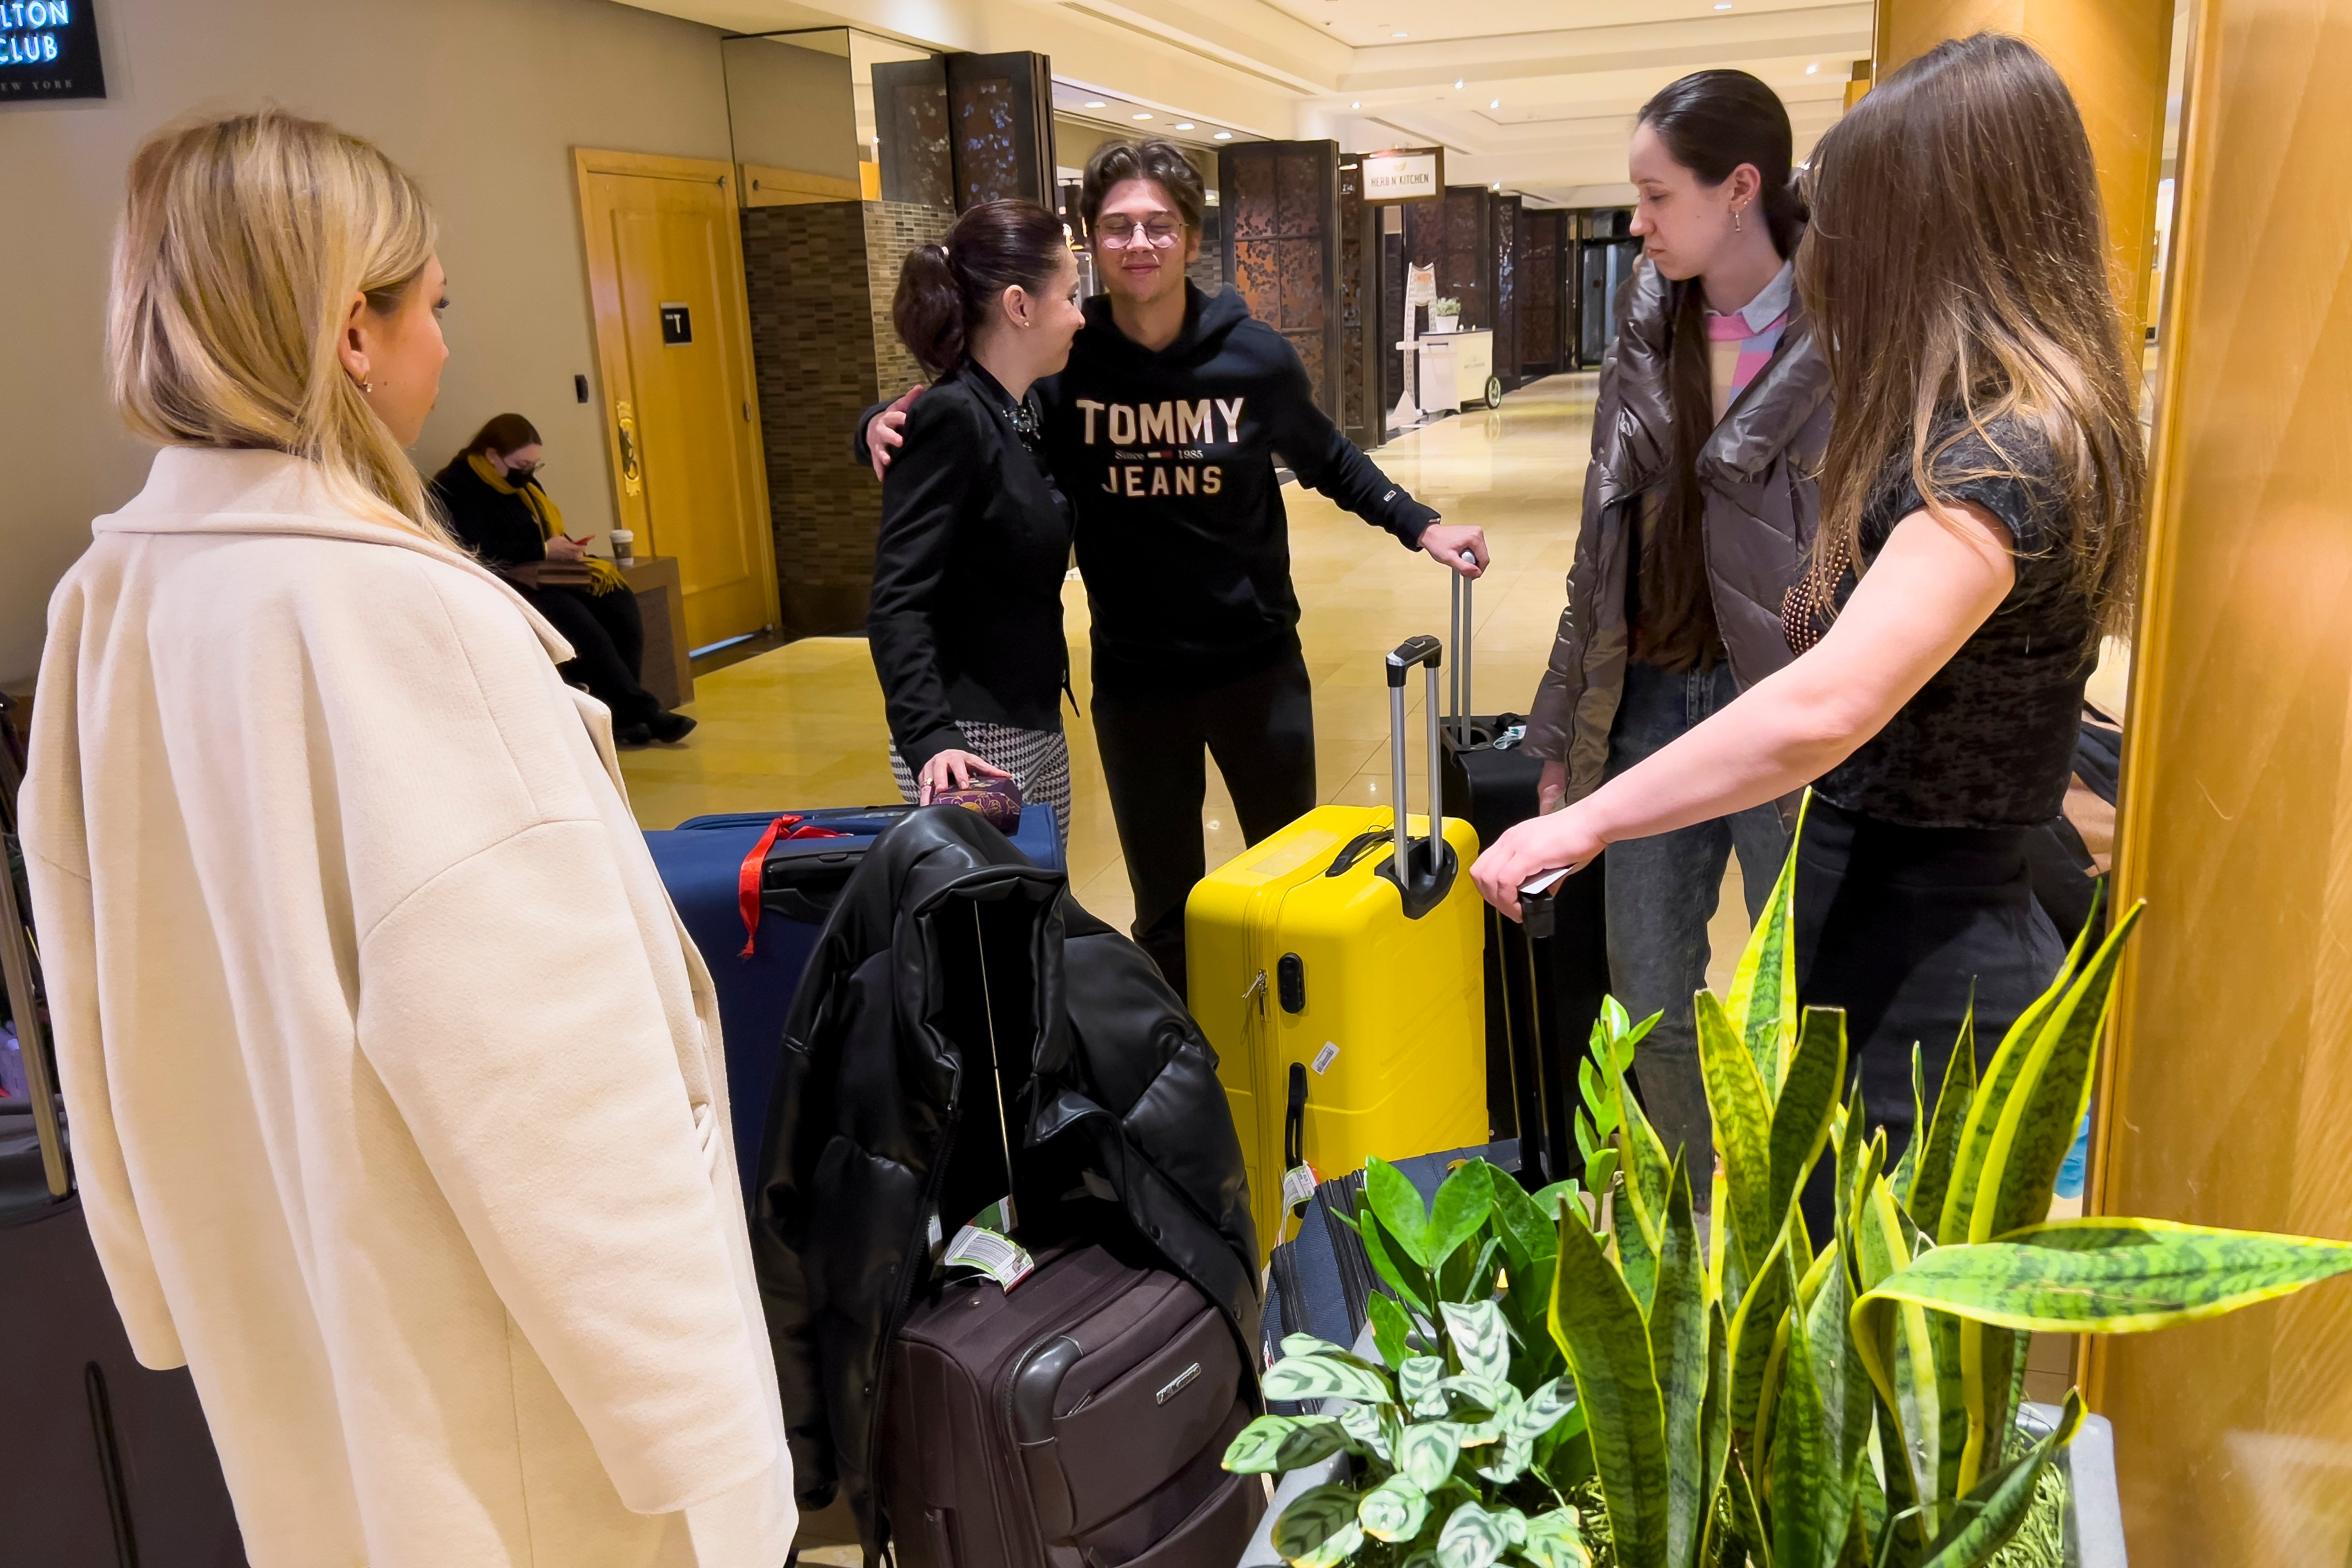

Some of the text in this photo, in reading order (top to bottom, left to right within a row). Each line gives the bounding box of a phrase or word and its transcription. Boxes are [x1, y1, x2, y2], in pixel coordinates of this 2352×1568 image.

[32, 80, 72, 90] YORK
[1371, 176, 1390, 187] HERB
[1399, 174, 1429, 184] KITCHEN
[1076, 398, 1244, 444] TOMMY
[1178, 450, 1203, 459] 1985
[1101, 466, 1222, 496] JEANS
